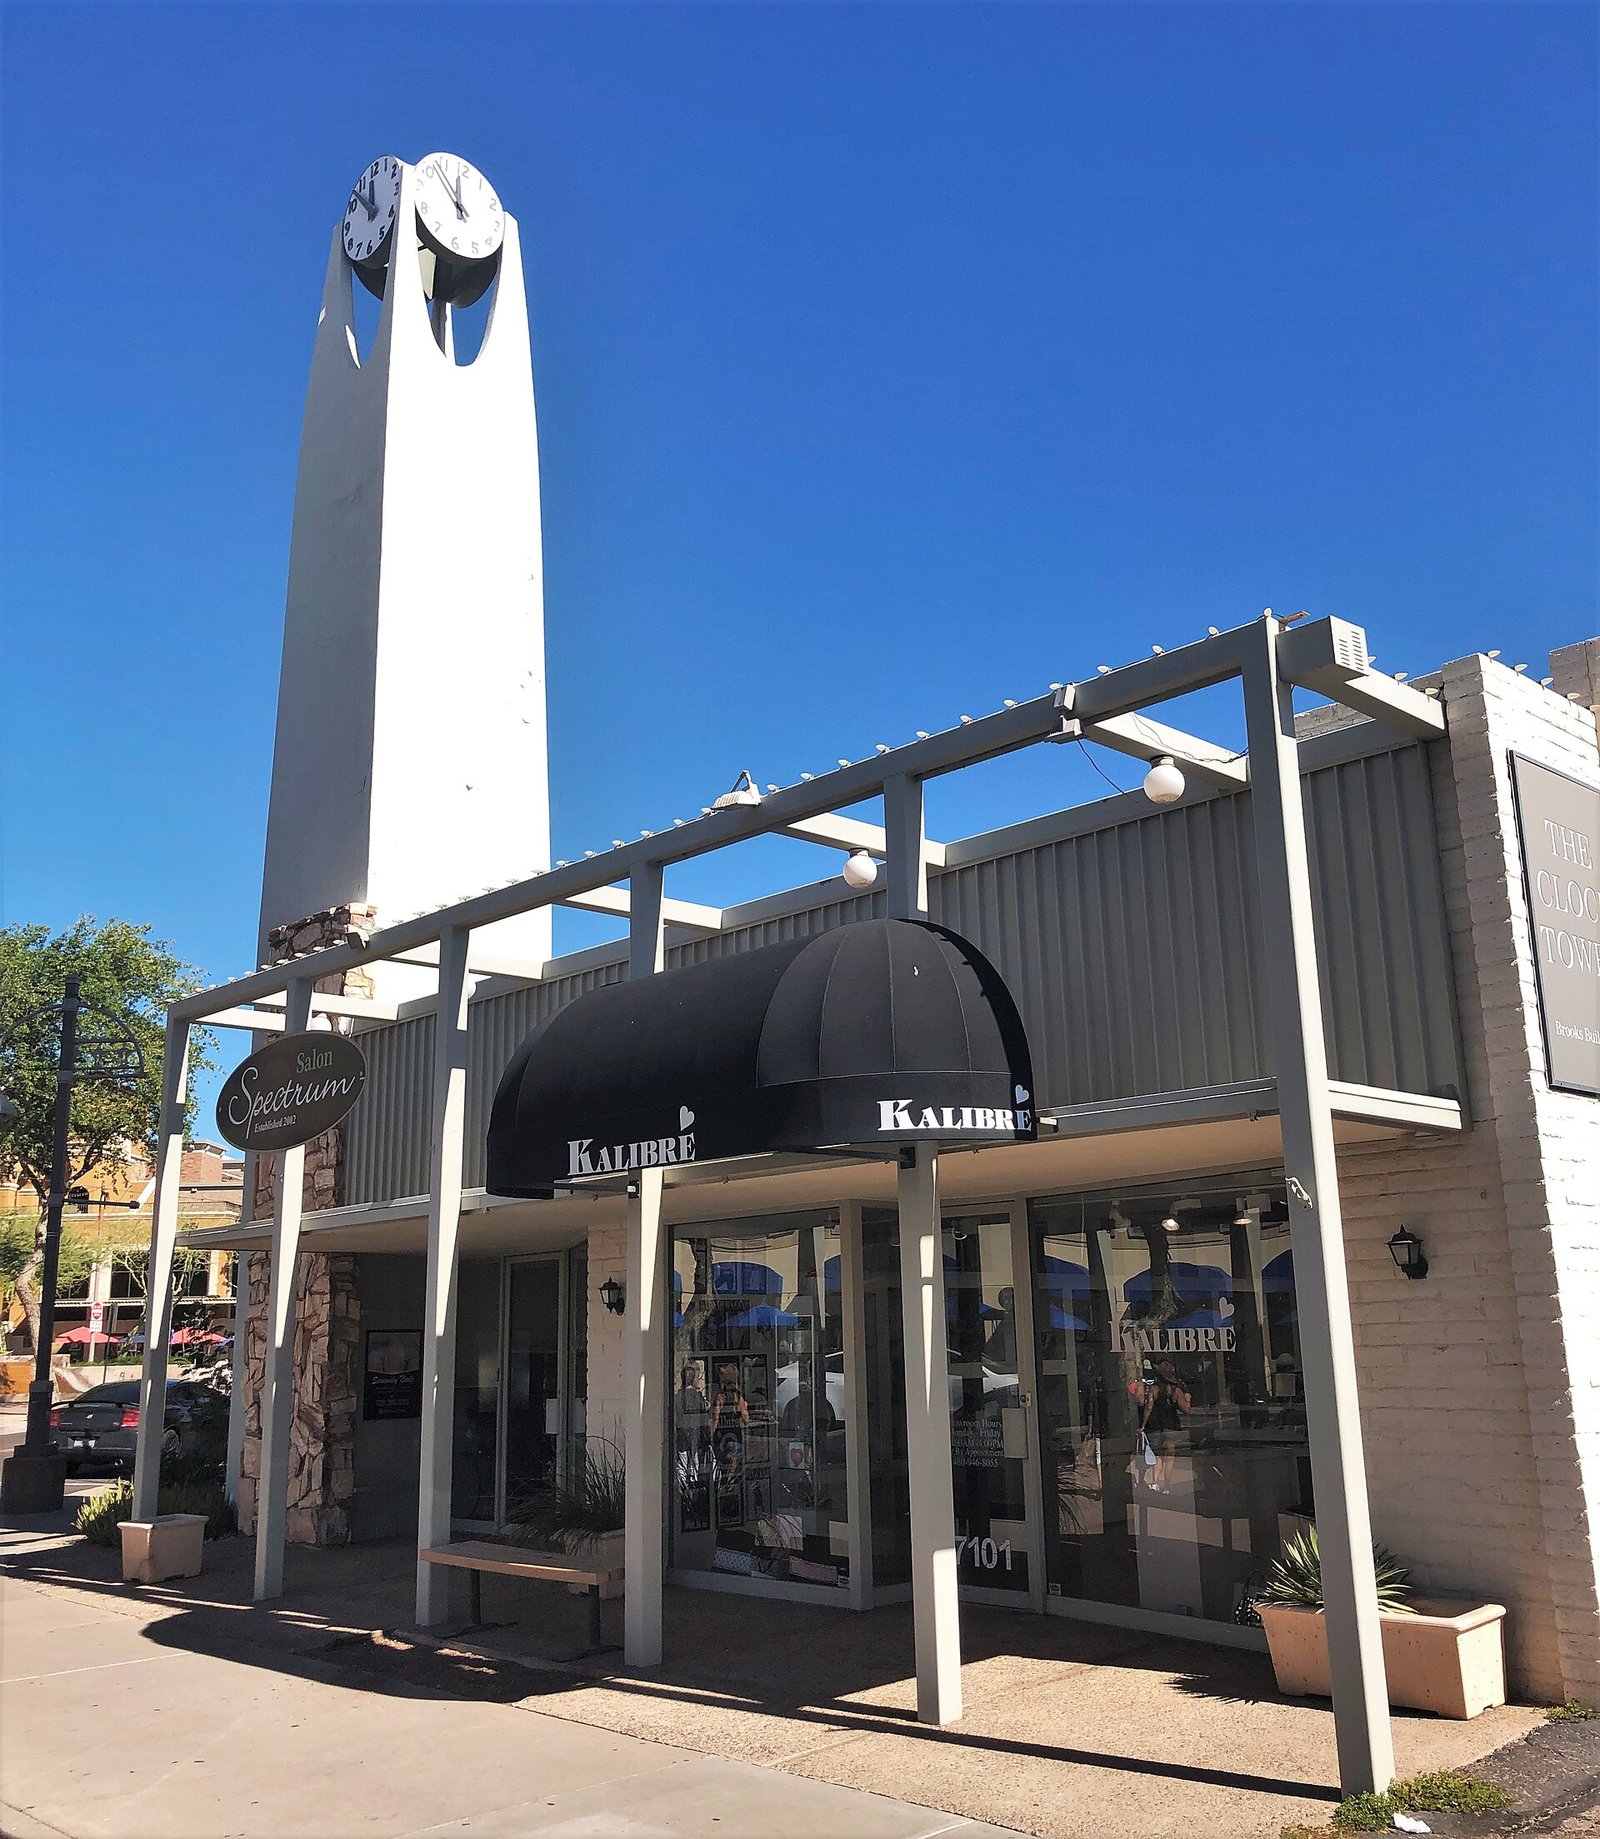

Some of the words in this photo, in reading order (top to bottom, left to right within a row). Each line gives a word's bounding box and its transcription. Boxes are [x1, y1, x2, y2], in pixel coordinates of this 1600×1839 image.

[370, 161, 380, 179] 12
[391, 163, 397, 180] 2
[457, 161, 469, 179] 12
[358, 175, 366, 193] 11
[393, 181, 400, 196] 3
[348, 198, 357, 216] 10
[387, 204, 395, 218] 4
[420, 200, 428, 216] 8
[489, 197, 498, 212] 2
[344, 221, 351, 237] 9
[378, 224, 386, 241] 5
[434, 220, 443, 233] 7
[347, 237, 354, 252] 8
[355, 241, 363, 258] 7
[366, 239, 373, 255] 6
[451, 236, 460, 251] 6
[471, 241, 480, 255] 5
[1544, 818, 1593, 870] THE
[1537, 869, 1600, 923] CLOC
[1555, 1020, 1584, 1041] Brooks
[296, 1048, 333, 1074] Salon
[228, 1066, 356, 1140] Spectrum
[254, 1117, 283, 1133] Established
[283, 1114, 297, 1127] 2002
[953, 1419, 980, 1428] owroom
[981, 1418, 1003, 1428] Hours
[979, 1427, 1000, 1438] Friday
[955, 1535, 1012, 1571] 7101
